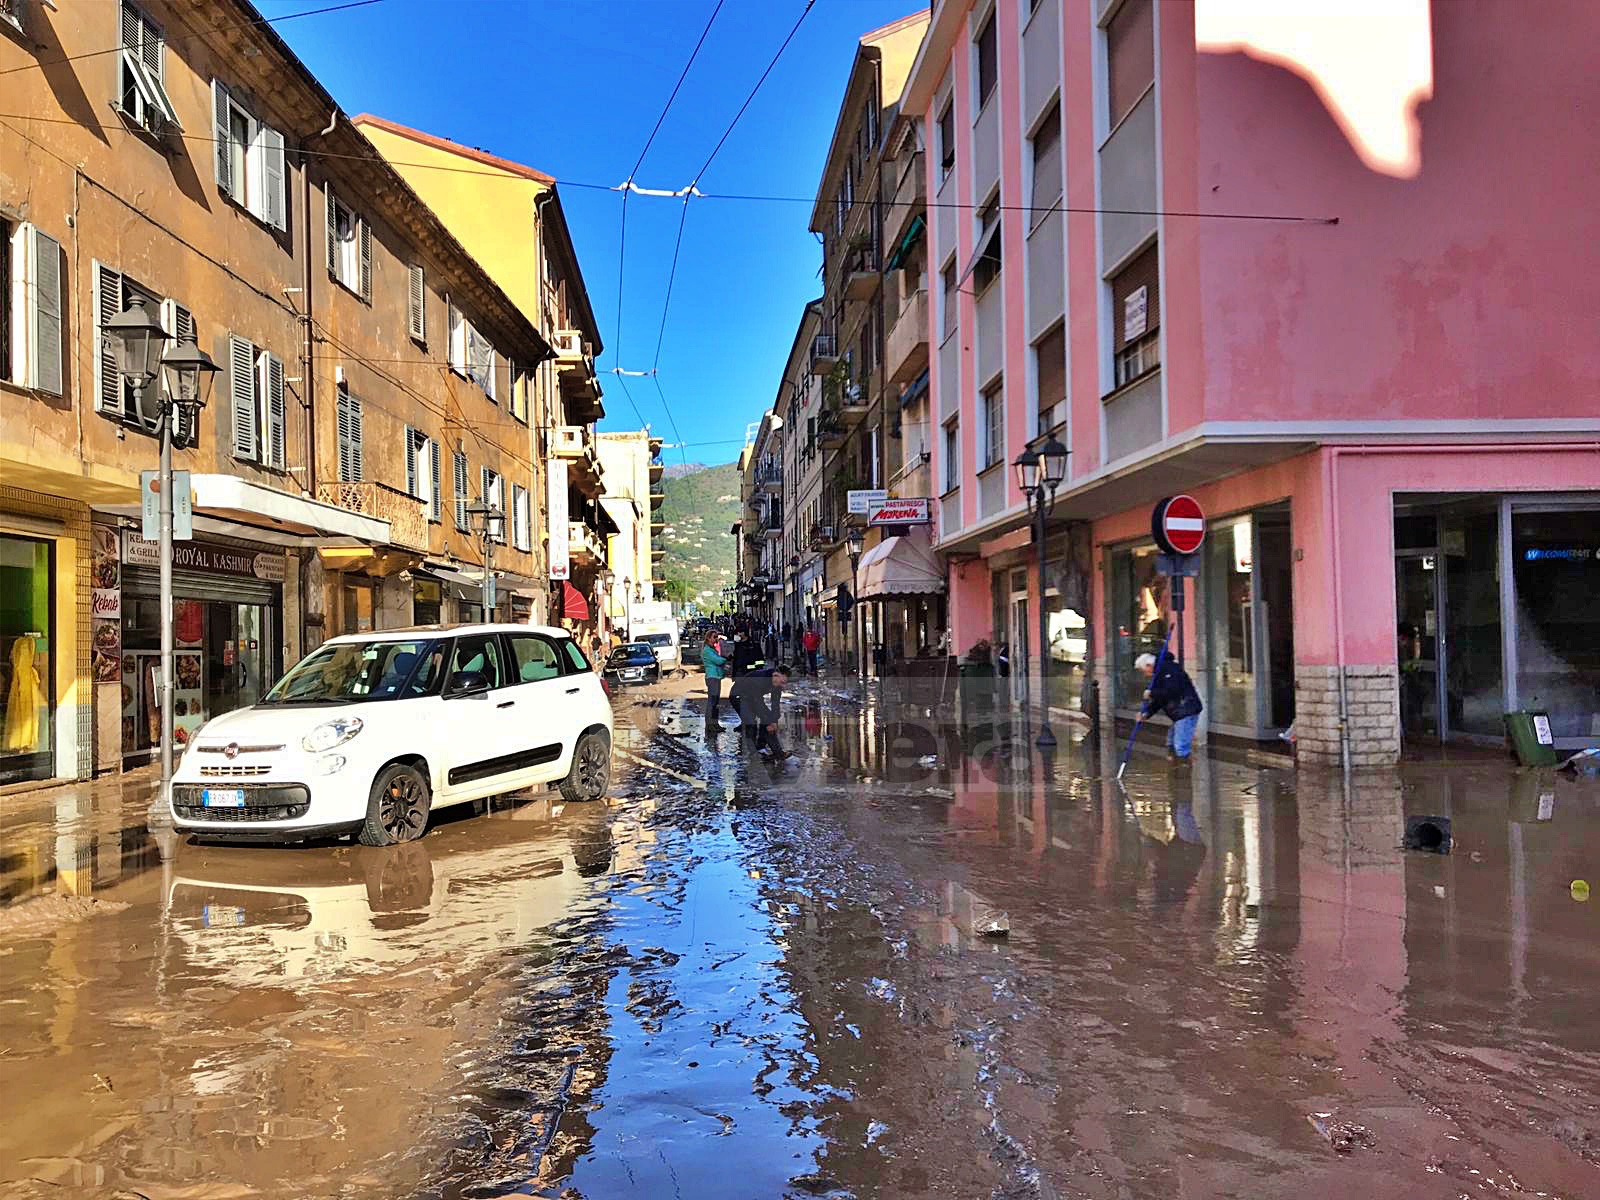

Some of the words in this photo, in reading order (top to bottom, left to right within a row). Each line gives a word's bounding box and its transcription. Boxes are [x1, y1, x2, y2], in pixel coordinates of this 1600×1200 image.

[175, 547, 209, 568] ROYAL
[213, 553, 252, 574] KASHMIR
[92, 591, 118, 614] Kebab
